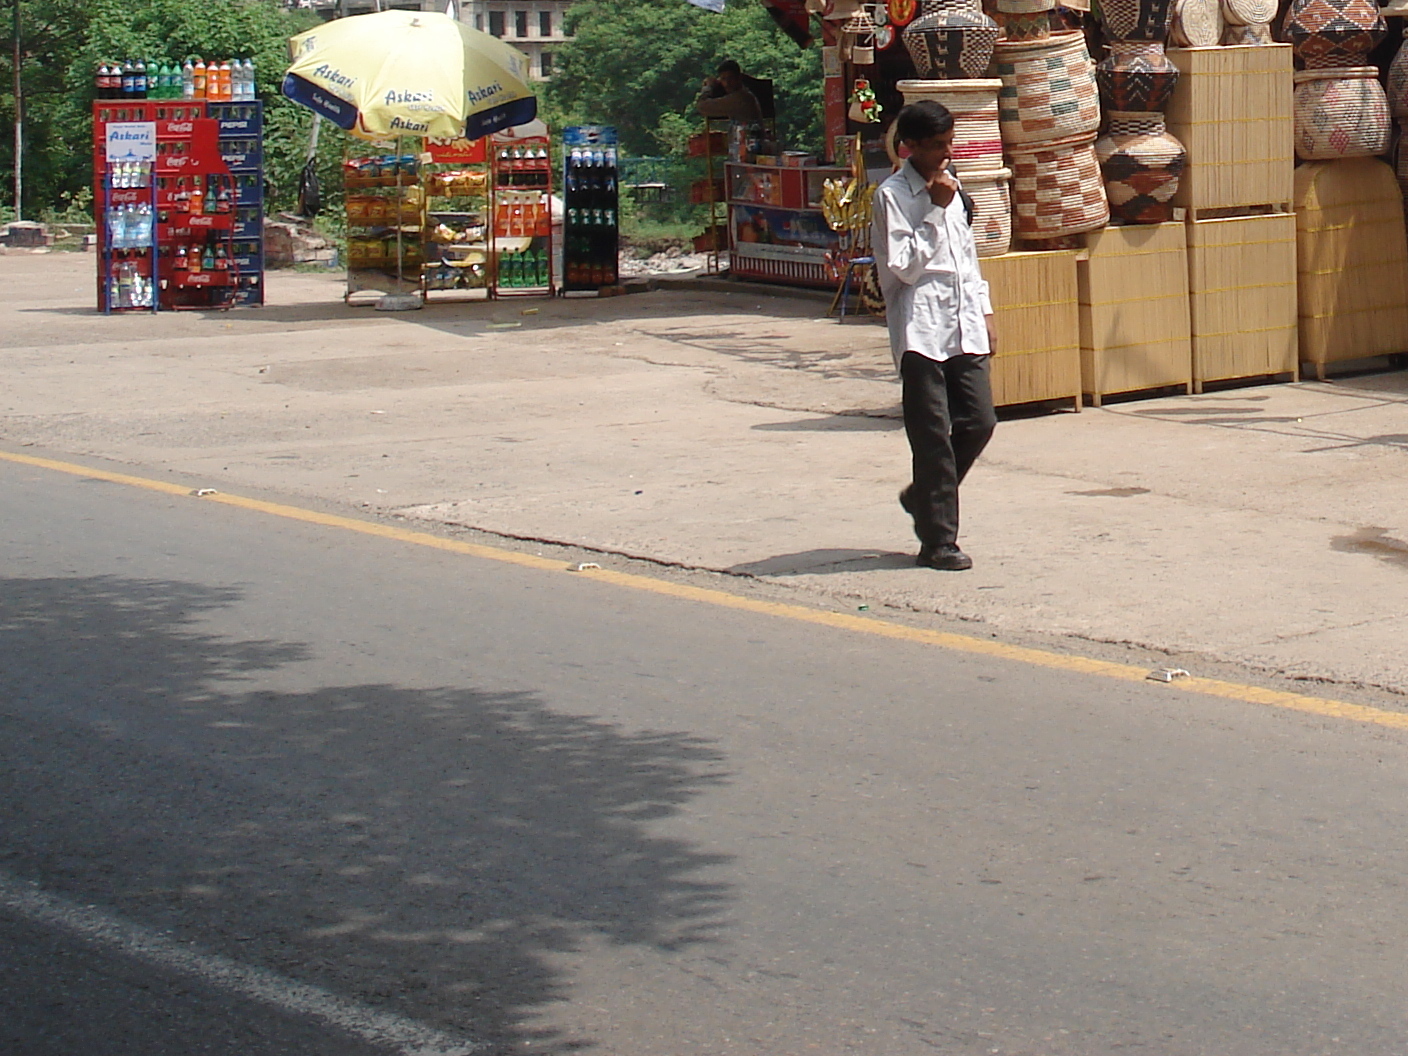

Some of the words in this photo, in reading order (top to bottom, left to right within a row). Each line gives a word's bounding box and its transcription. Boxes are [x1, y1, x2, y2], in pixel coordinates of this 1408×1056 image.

[313, 64, 358, 88] Askari
[385, 89, 433, 105] Askari
[466, 80, 503, 105] Askari
[390, 116, 430, 132] Askari
[110, 130, 149, 142] Askari
